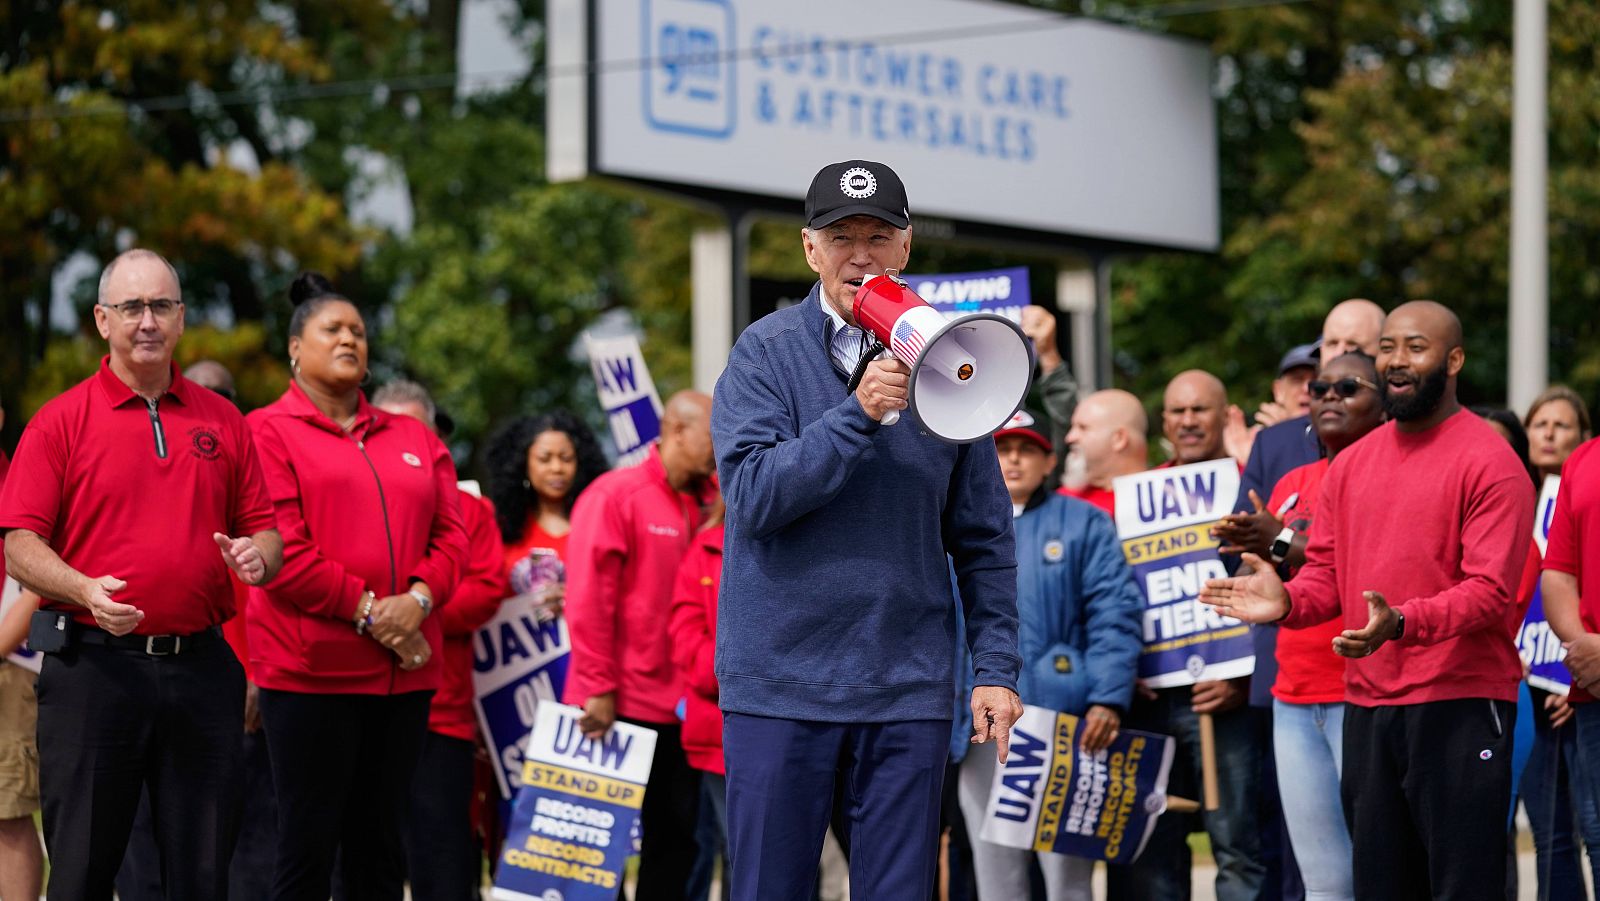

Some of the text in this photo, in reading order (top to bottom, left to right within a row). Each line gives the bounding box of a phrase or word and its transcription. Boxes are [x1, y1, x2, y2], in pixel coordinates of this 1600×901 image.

[976, 64, 1071, 119] CARE
[756, 81, 1036, 162] & AFTERSALES
[850, 178, 868, 187] UAW
[916, 275, 1011, 305] SAVING
[1136, 472, 1215, 523] UAW
[1130, 532, 1198, 560] STAND
[1145, 559, 1229, 605] END
[473, 616, 561, 673] UAW
[553, 714, 633, 771] UAW
[532, 767, 635, 801] STAND UP
[994, 727, 1048, 823] UAW
[1040, 724, 1072, 844] STAND UP
[1065, 750, 1093, 834] RECOR
[1097, 752, 1125, 838] RECORD
[1104, 736, 1147, 859] CONTRACTS
[530, 814, 611, 847] PROFITS
[533, 796, 615, 829] RECORD
[503, 848, 617, 889] CONTRACTS
[525, 834, 605, 866] RECORD
